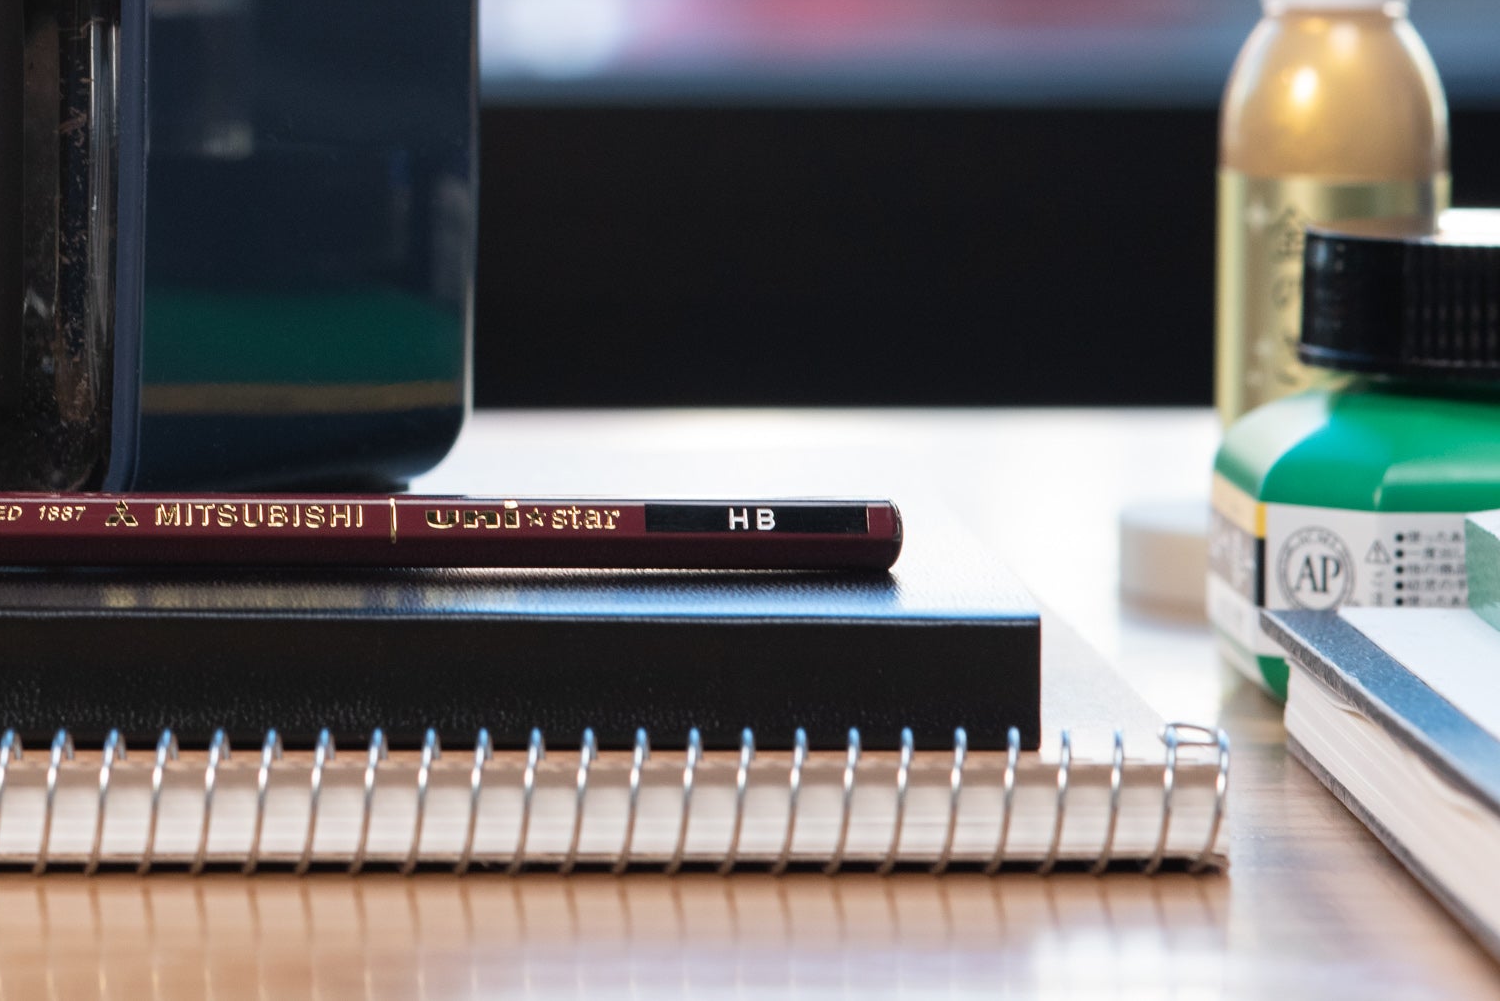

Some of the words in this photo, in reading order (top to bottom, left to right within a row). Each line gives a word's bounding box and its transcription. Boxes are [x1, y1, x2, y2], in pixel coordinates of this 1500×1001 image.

[38, 505, 86, 521] 1887
[155, 503, 363, 528] MITSUBISHI
[728, 507, 776, 530] HB
[1294, 555, 1341, 593] AP
